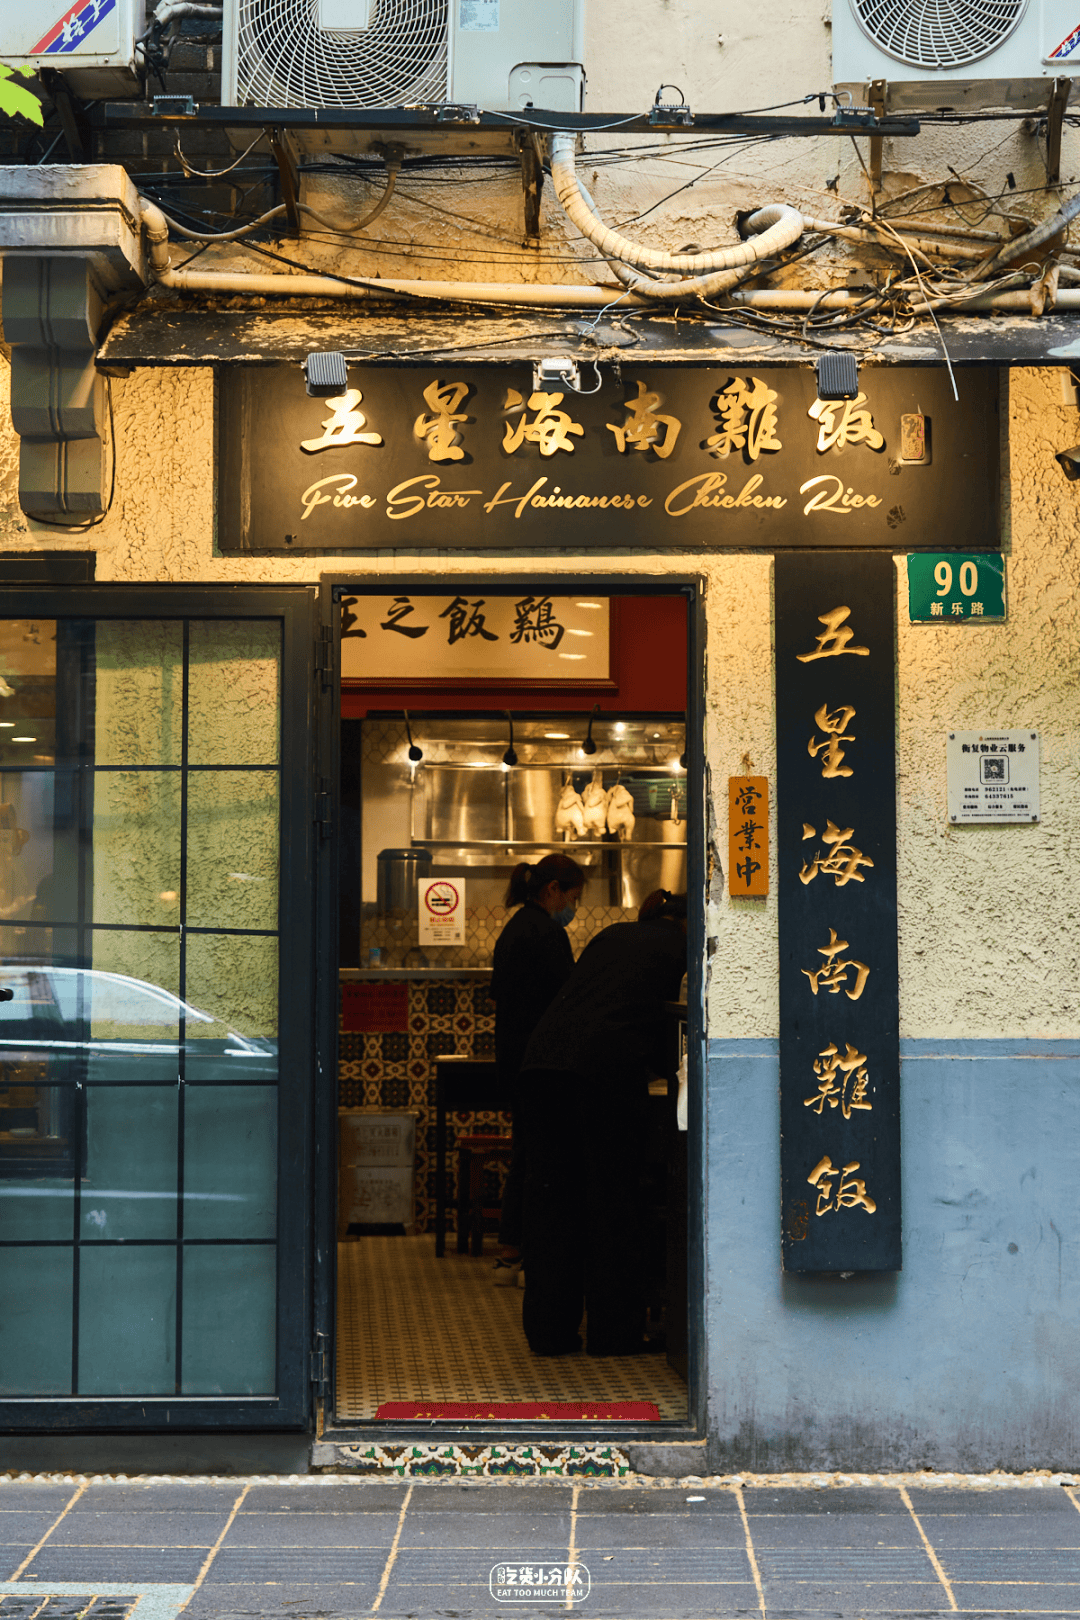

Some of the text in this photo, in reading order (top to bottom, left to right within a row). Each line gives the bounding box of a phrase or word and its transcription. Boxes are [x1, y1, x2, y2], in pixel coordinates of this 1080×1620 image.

[300, 472, 883, 520] Five Star Hainanese Chicken Rice
[934, 561, 978, 597] 90
[930, 602, 984, 616] 新乐路
